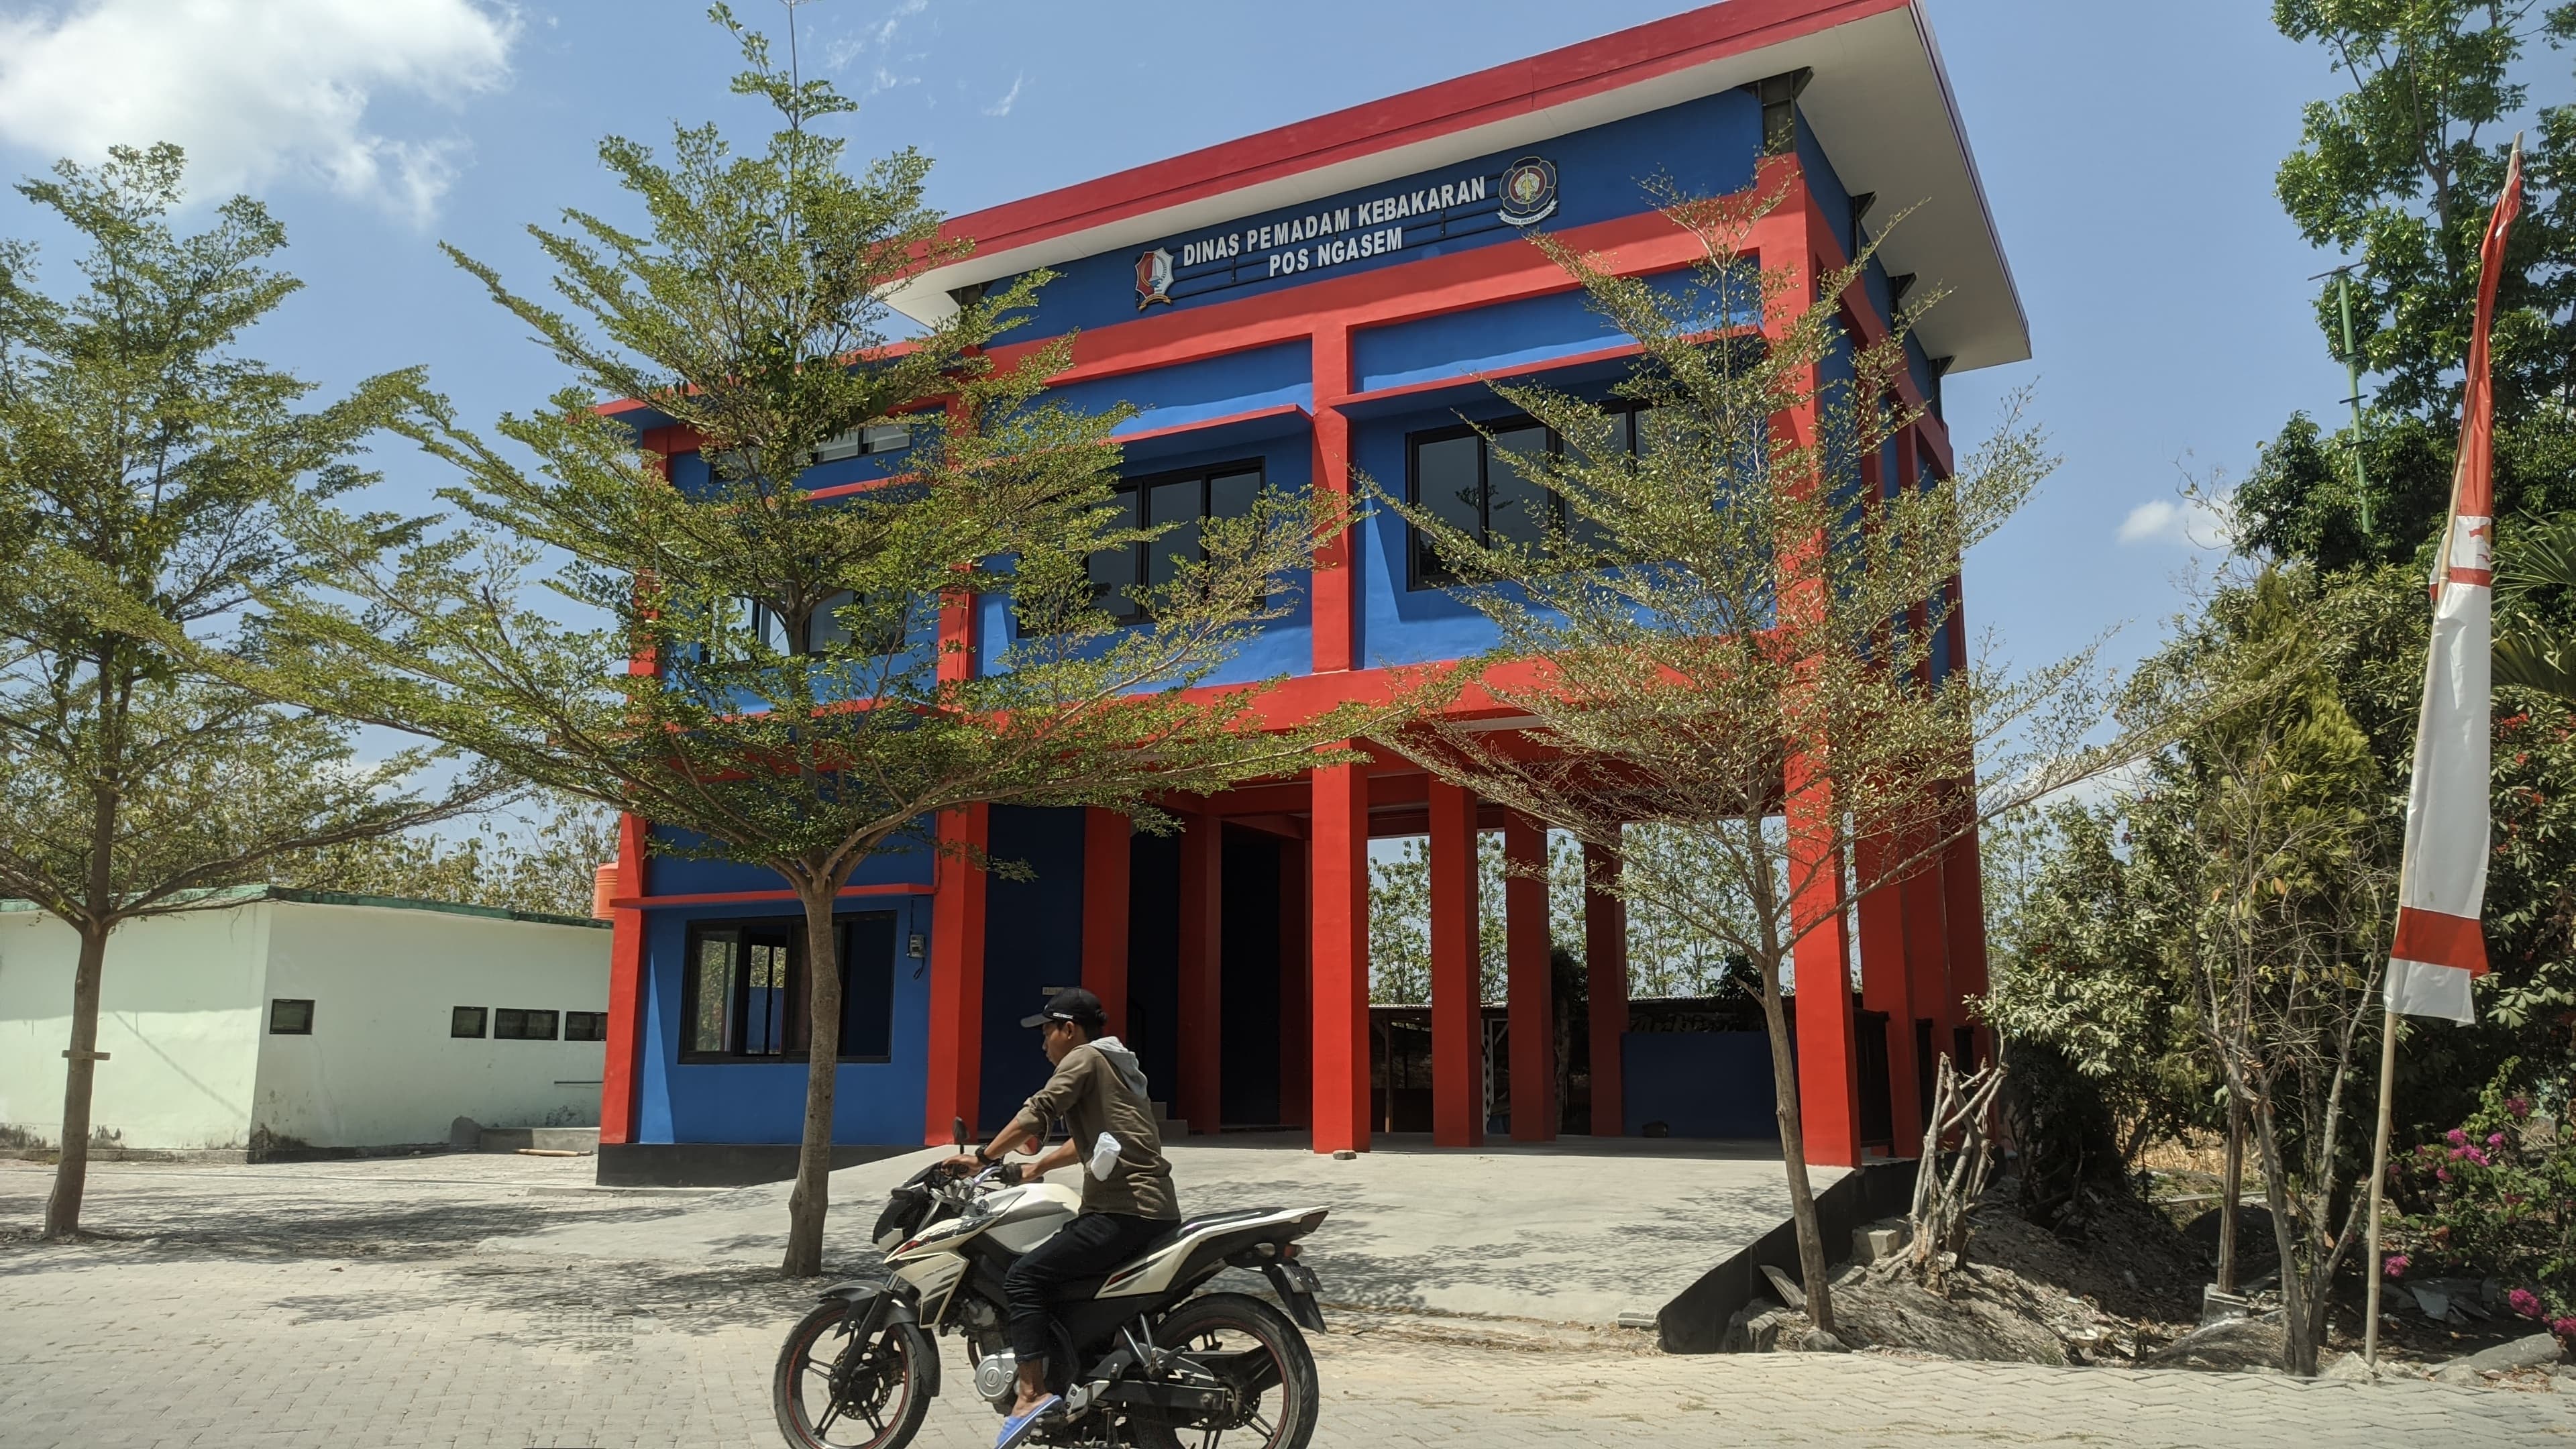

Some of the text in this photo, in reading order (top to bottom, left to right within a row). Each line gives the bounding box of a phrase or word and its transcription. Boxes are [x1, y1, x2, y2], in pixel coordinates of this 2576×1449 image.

[1184, 176, 1485, 266] DINAS PEMADAM KEBAKARAN
[1269, 227, 1402, 277] POS NGASEM
